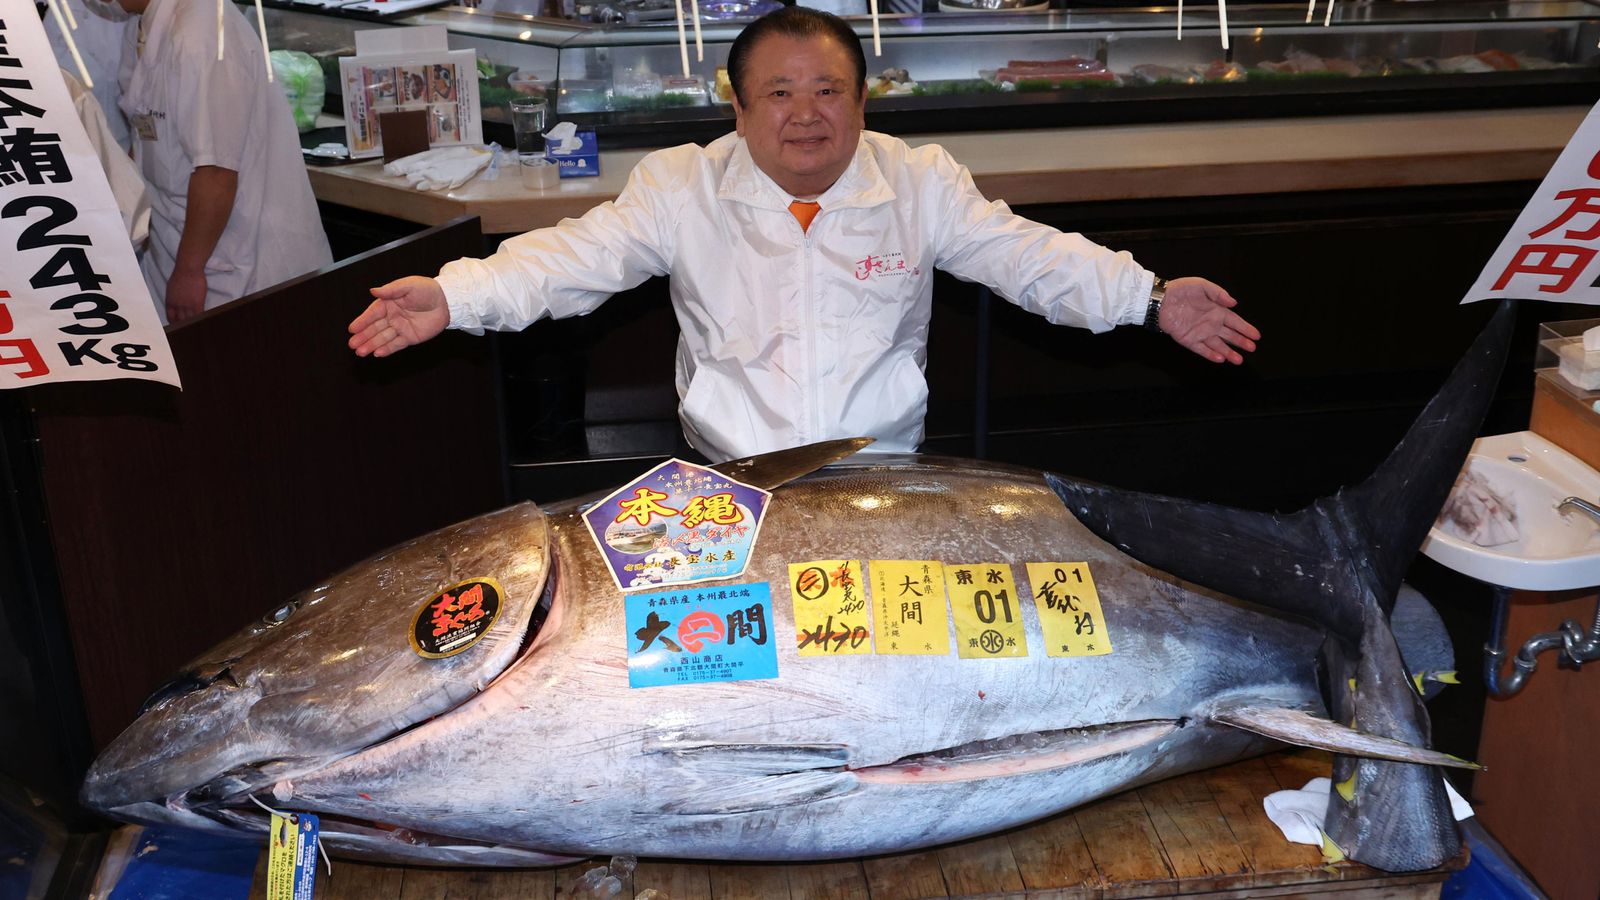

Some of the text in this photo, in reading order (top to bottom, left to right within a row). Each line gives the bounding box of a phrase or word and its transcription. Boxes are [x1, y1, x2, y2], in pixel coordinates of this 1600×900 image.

[559, 160, 576, 168] Hello
[615, 487, 744, 528] 本縄
[921, 564, 934, 595] 青森県
[954, 569, 1005, 585] 東水
[1054, 568, 1083, 584] 01
[696, 589, 751, 602] 本州最北端
[898, 575, 924, 625] 大間
[974, 589, 1014, 625] 01
